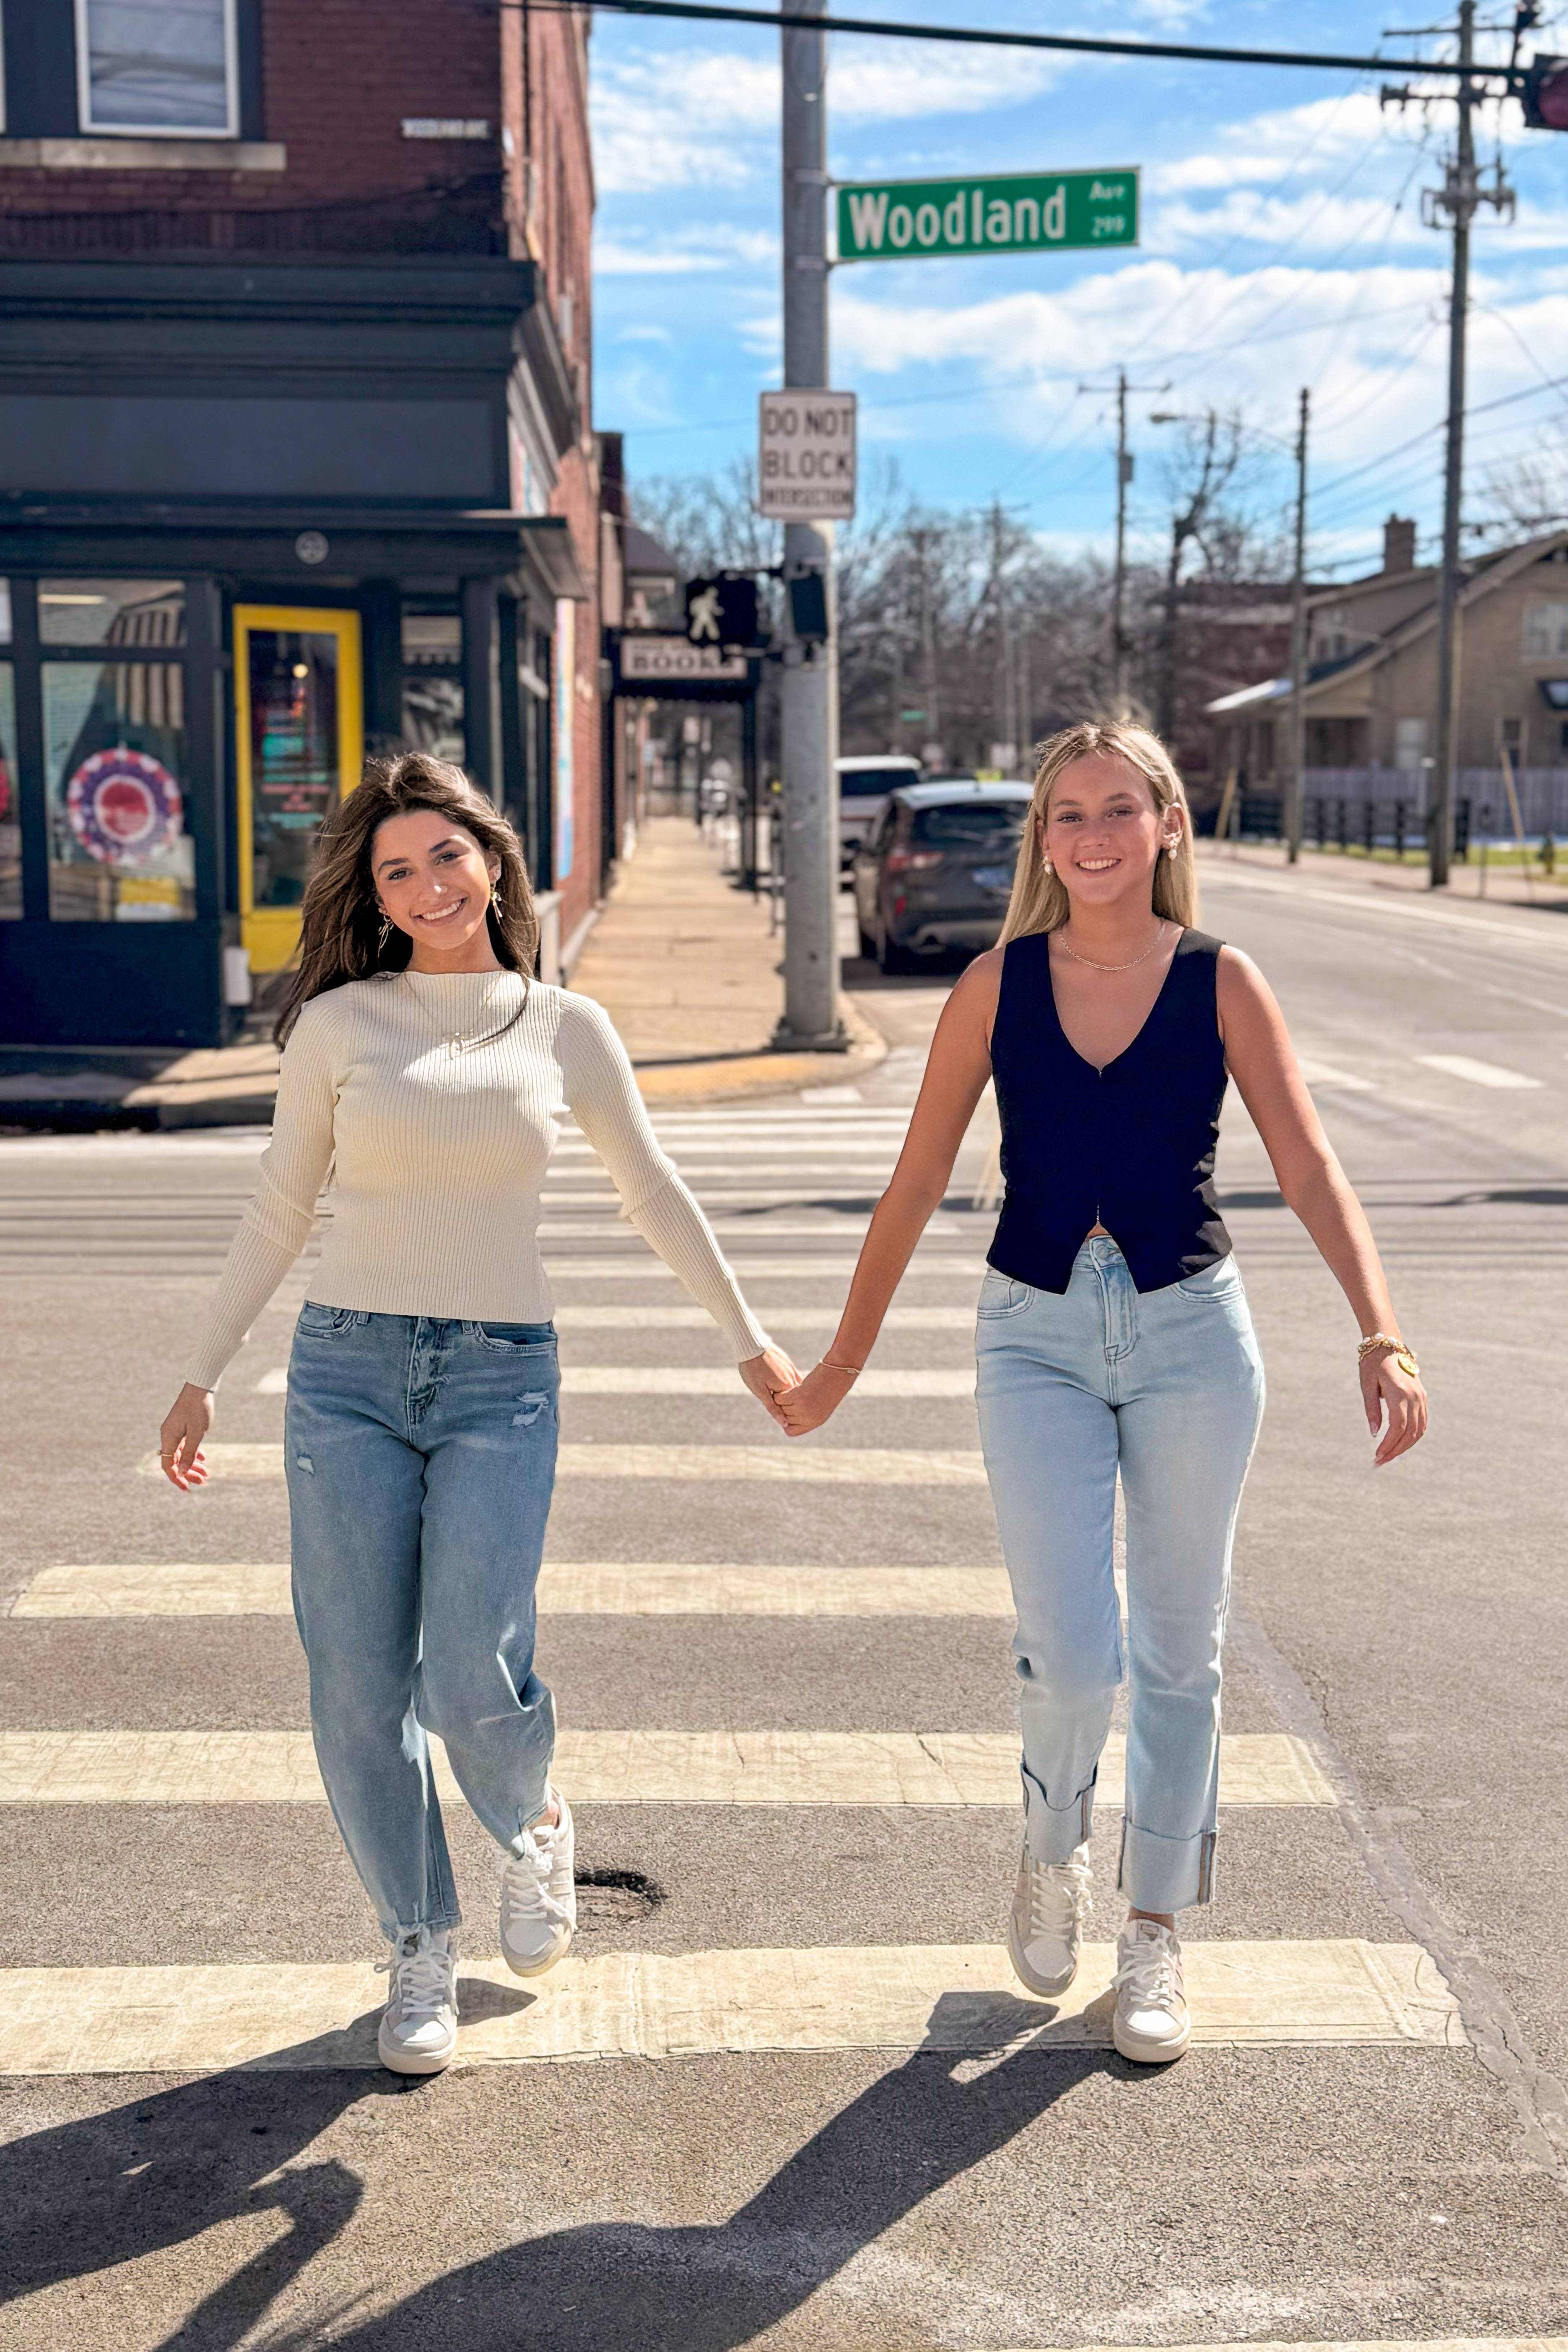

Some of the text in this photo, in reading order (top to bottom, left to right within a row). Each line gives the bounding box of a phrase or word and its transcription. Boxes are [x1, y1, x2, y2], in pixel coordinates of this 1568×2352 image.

[1089, 180, 1126, 201] Ave
[848, 184, 1066, 250] Woodland
[765, 408, 853, 437] DO NOT
[765, 449, 853, 479] BLOCK
[632, 652, 732, 670] BOOK
